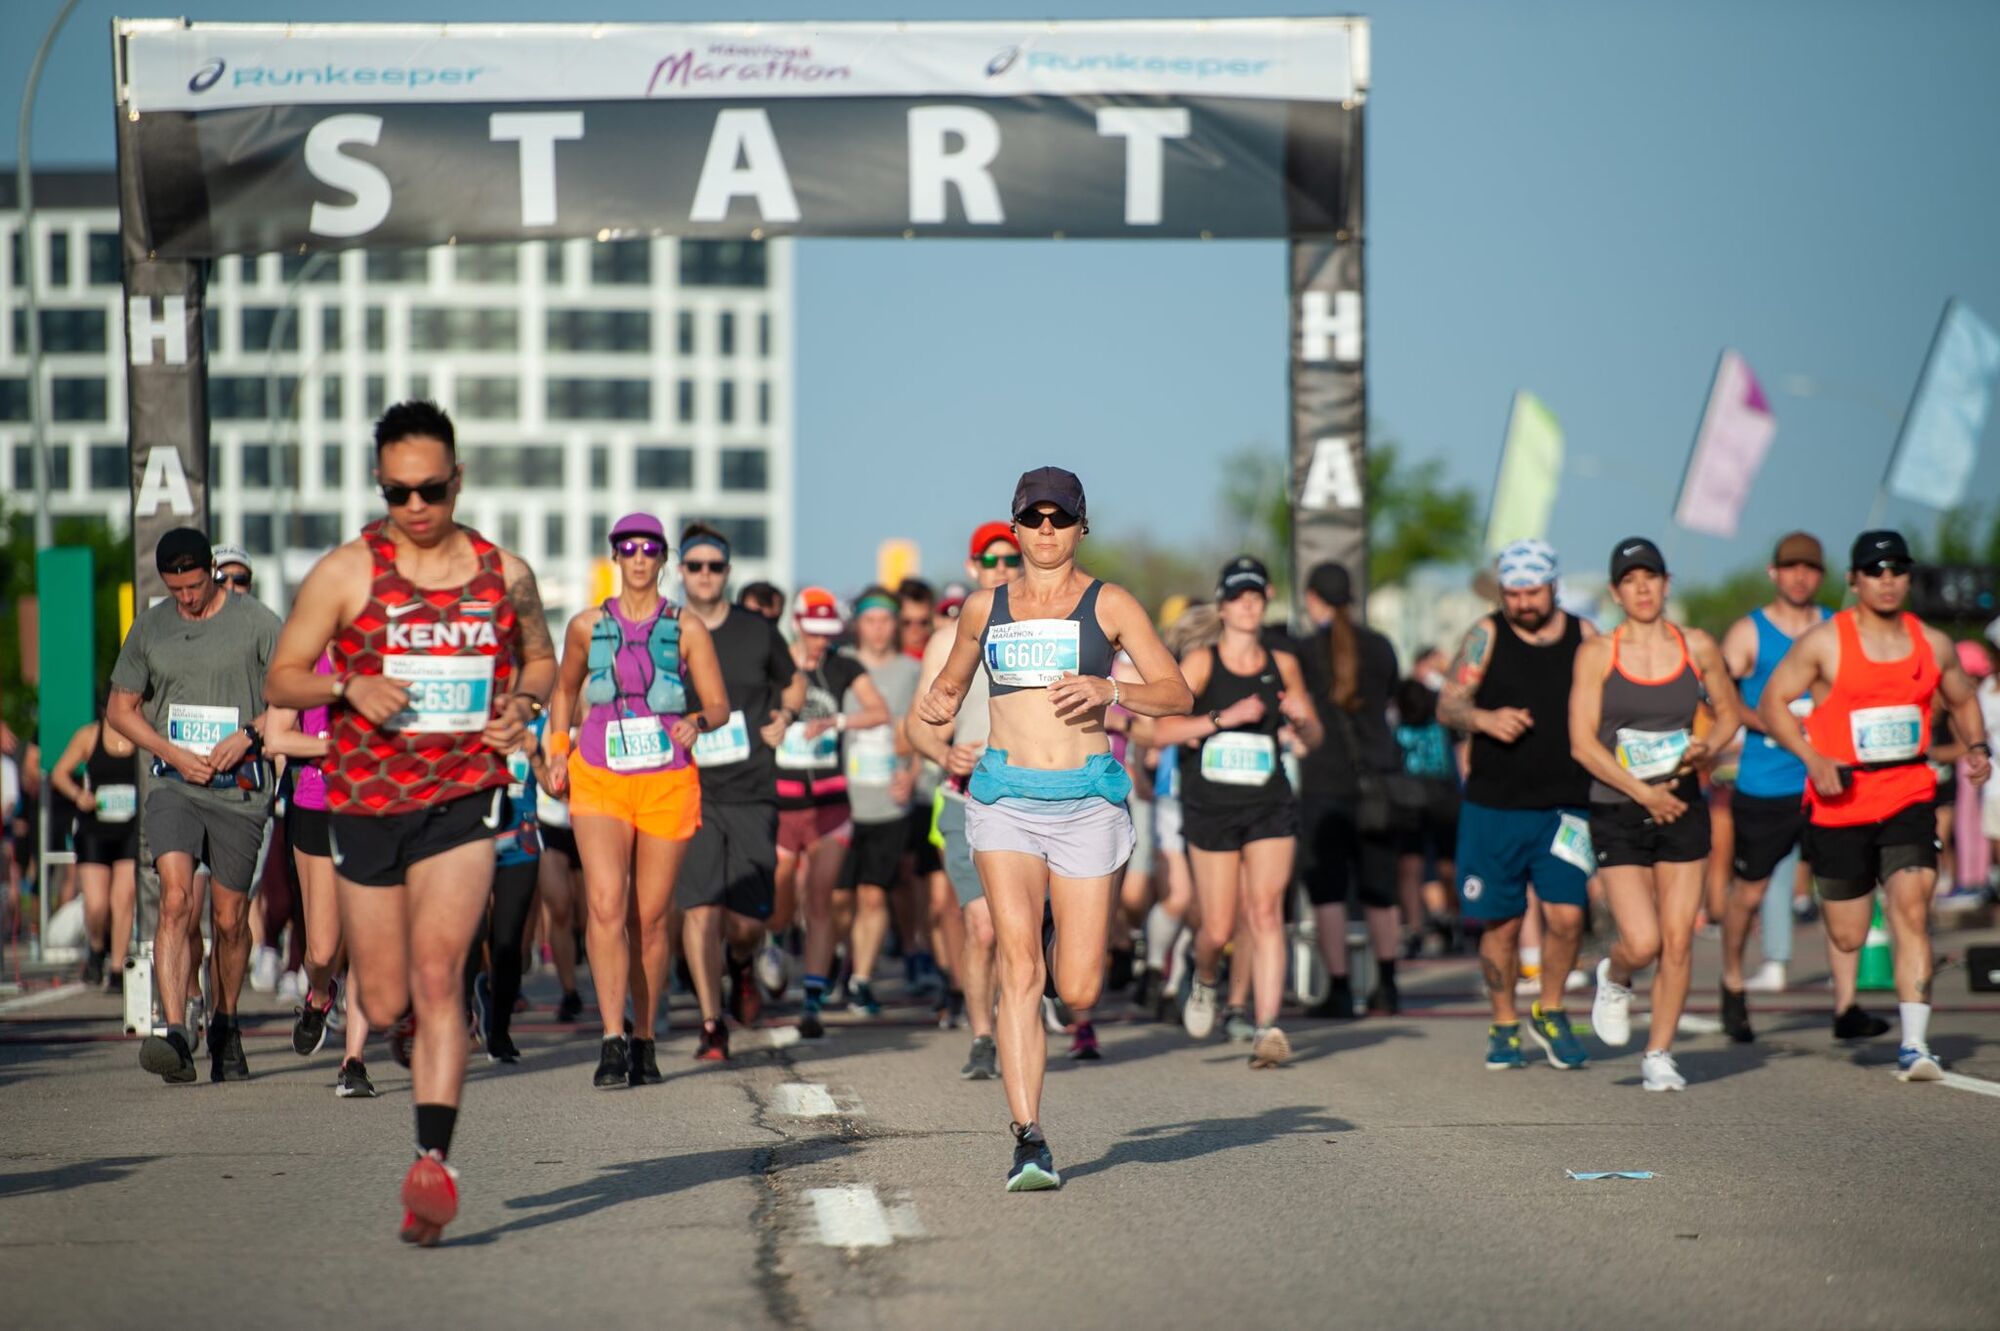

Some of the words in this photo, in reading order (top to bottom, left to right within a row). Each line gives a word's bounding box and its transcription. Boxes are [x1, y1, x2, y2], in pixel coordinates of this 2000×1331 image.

[233, 63, 482, 88] Runkeeper
[646, 50, 850, 97] Marathon
[1027, 51, 1270, 78] Runkeeper
[304, 106, 1190, 237] START
[386, 621, 499, 649] KENYA
[992, 626, 1011, 634] HALF
[992, 630, 1033, 639] MARATHON
[1004, 642, 1057, 668] 6602
[183, 721, 221, 742] 6254
